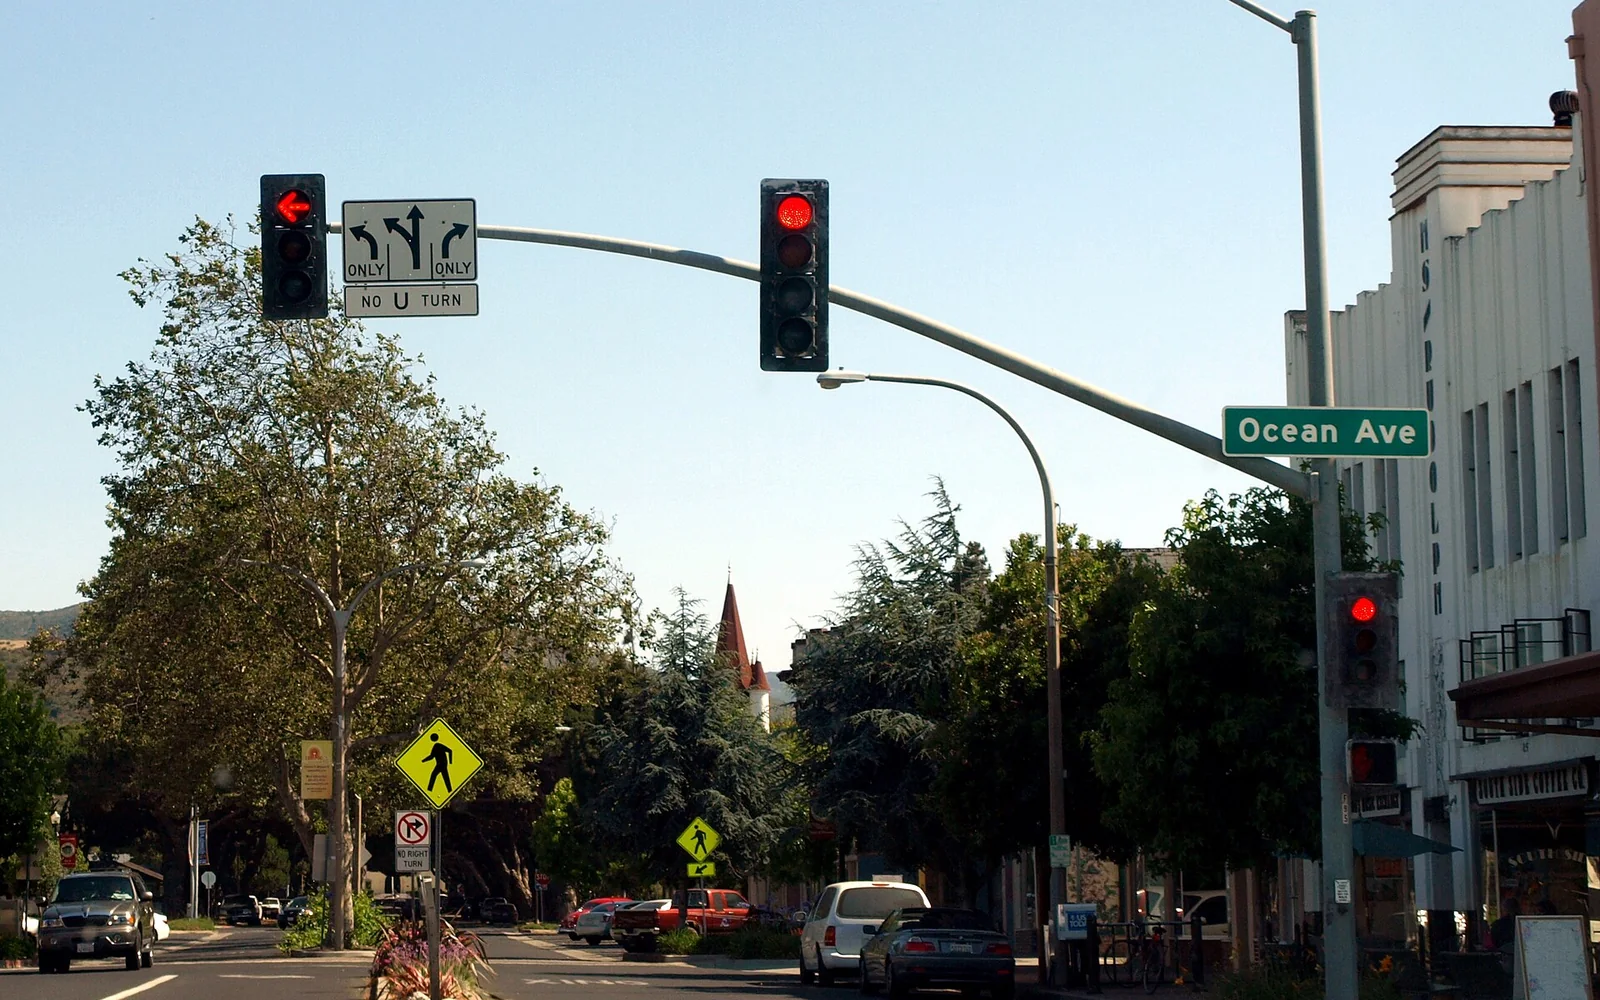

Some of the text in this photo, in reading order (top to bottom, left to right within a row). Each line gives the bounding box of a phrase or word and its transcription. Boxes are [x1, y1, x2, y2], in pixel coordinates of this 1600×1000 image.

[348, 263, 385, 277] ONLY
[435, 262, 472, 275] ONLY
[362, 292, 461, 310] NO U TURN
[1238, 417, 1416, 444] Ocean Ave
[397, 850, 428, 858] NO RIGHT
[404, 860, 423, 868] TURN
